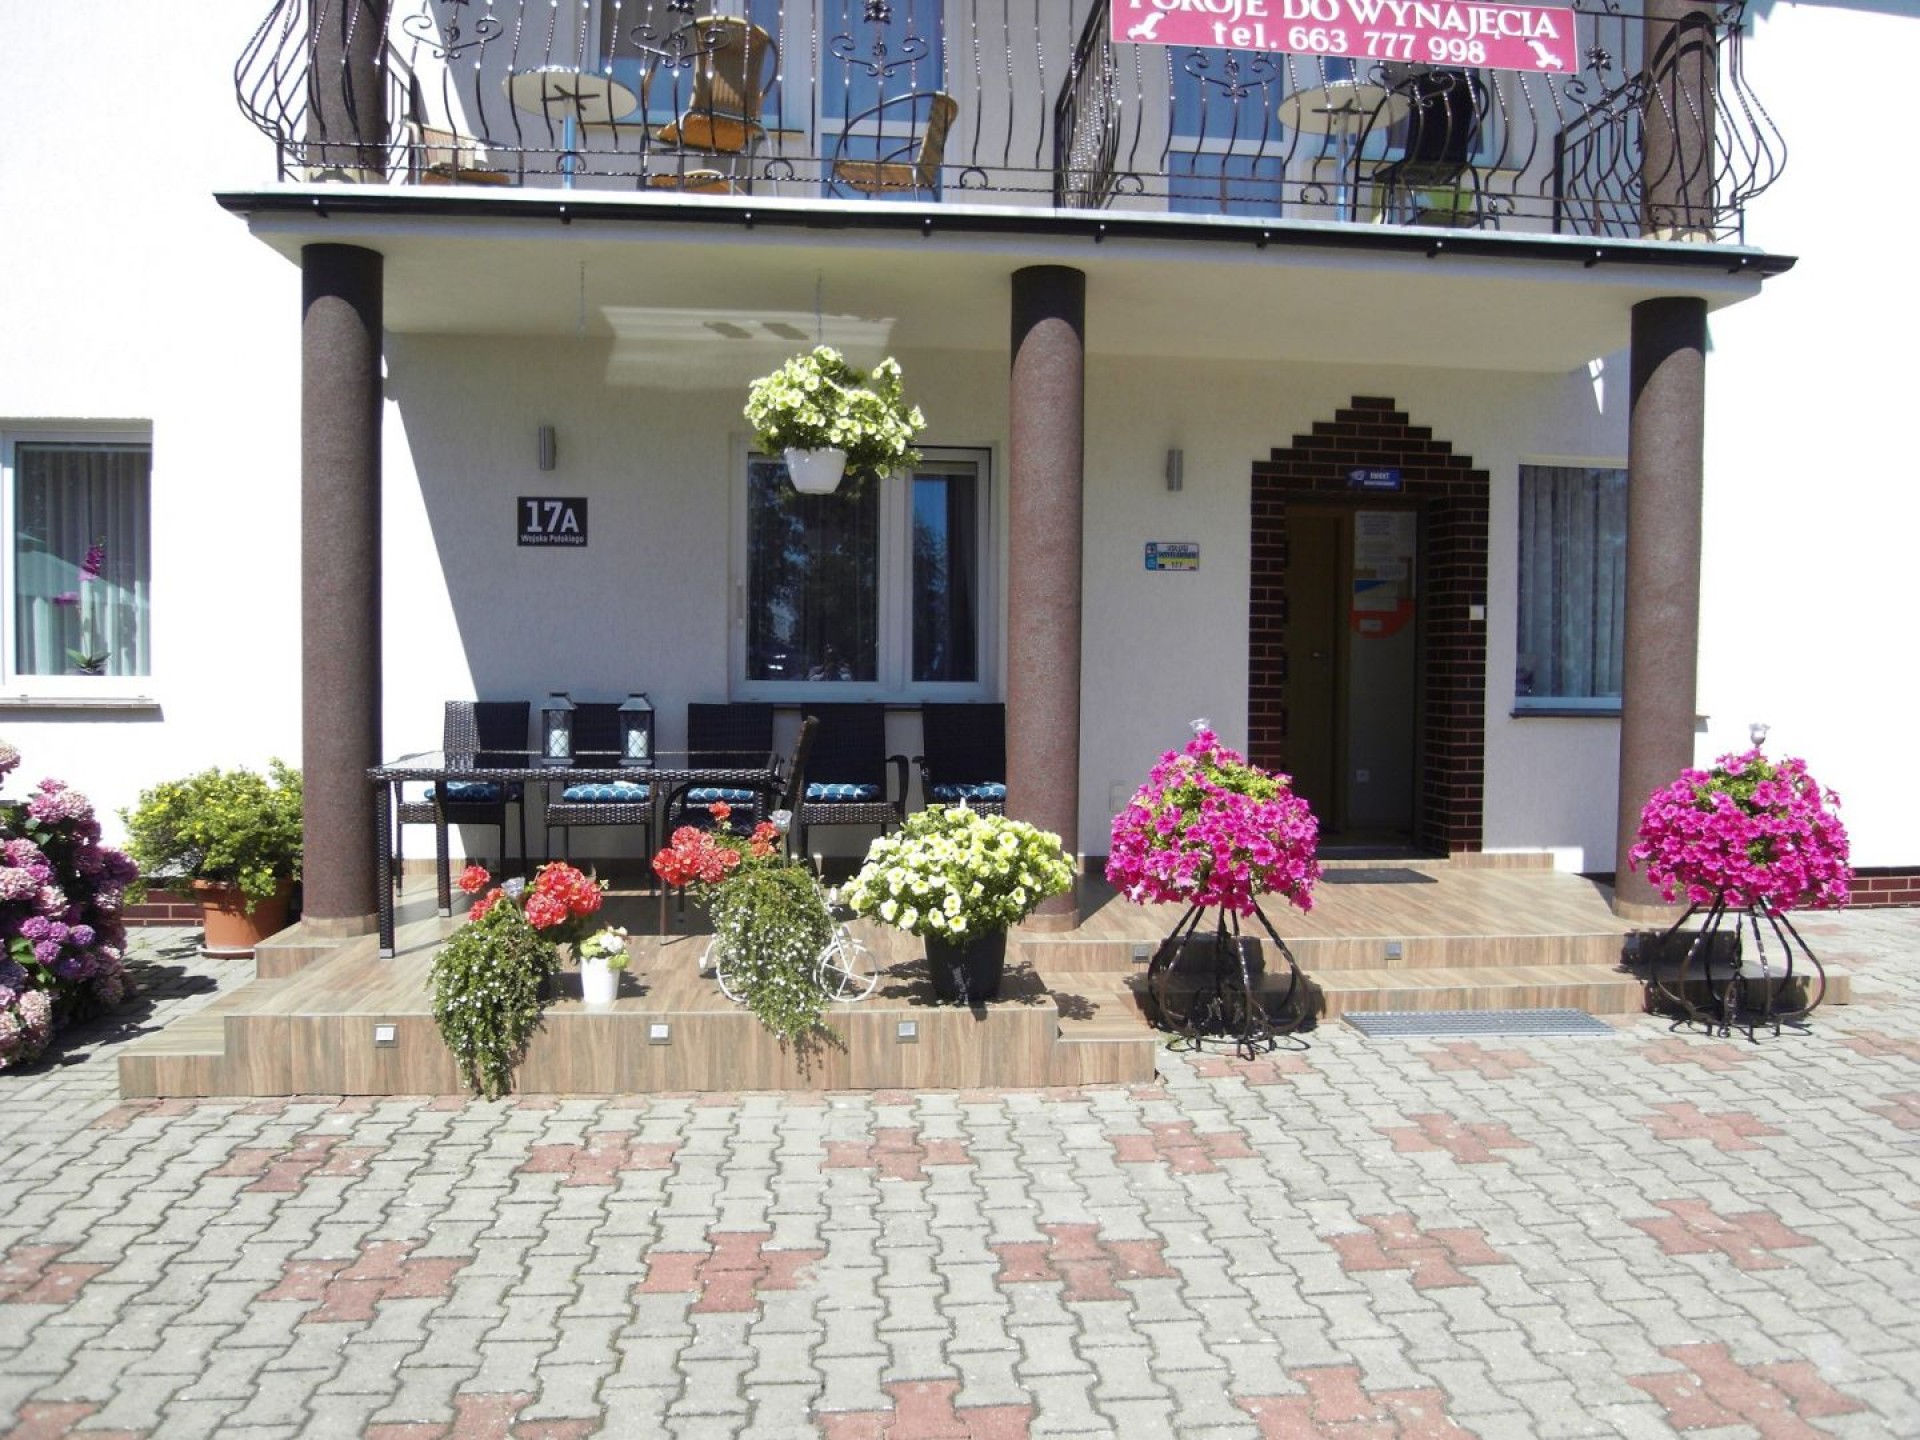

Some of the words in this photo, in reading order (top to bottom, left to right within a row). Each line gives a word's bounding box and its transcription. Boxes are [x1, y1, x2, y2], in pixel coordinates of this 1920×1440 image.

[1283, 0, 1340, 21] DO
[1346, 0, 1560, 41] WYNAJĘCIA
[1213, 21, 1277, 49] tel.
[1288, 26, 1348, 53] 663
[1363, 31, 1416, 58] 777
[1428, 36, 1486, 64] 998
[526, 500, 579, 533] 17A
